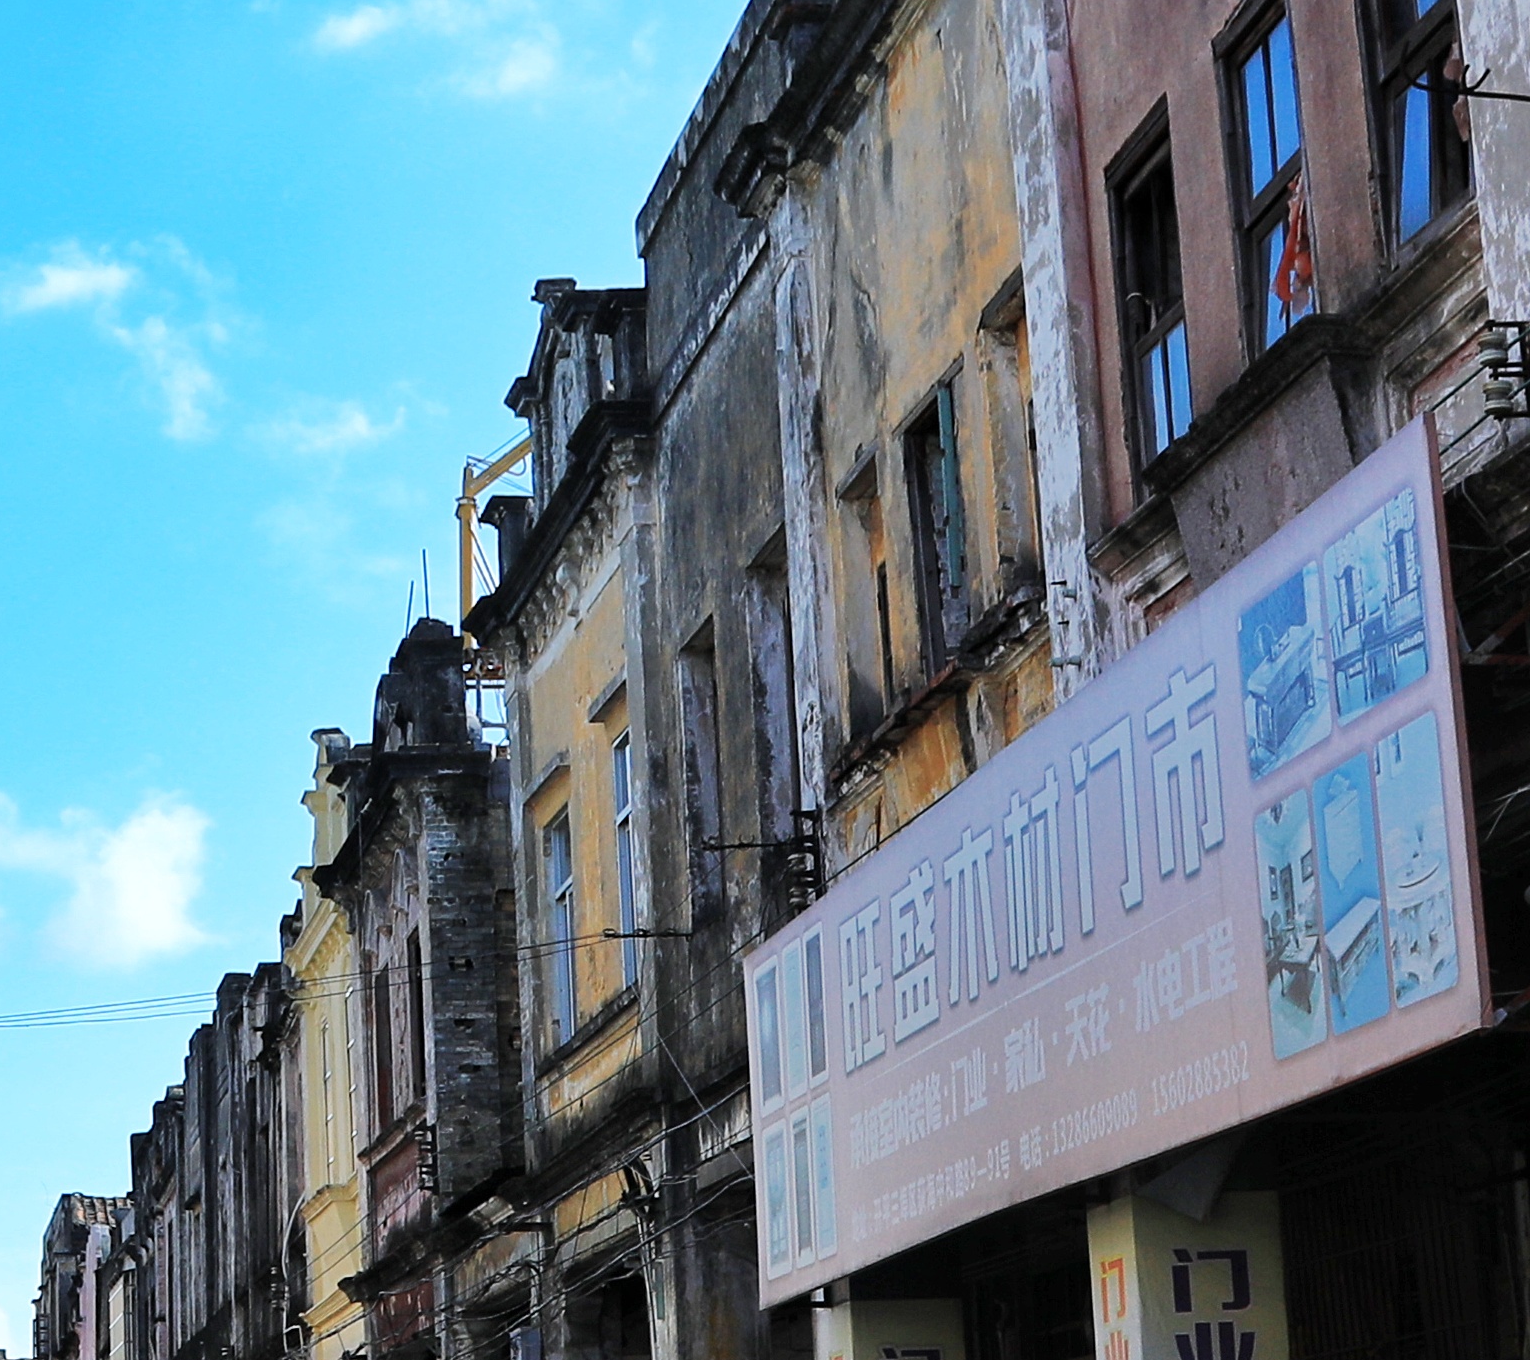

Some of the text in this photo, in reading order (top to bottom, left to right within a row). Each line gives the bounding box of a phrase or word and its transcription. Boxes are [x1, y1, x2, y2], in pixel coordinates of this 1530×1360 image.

[839, 663, 1226, 1077] 旺盛木材门市
[1151, 1041, 1250, 1116] 15602885382
